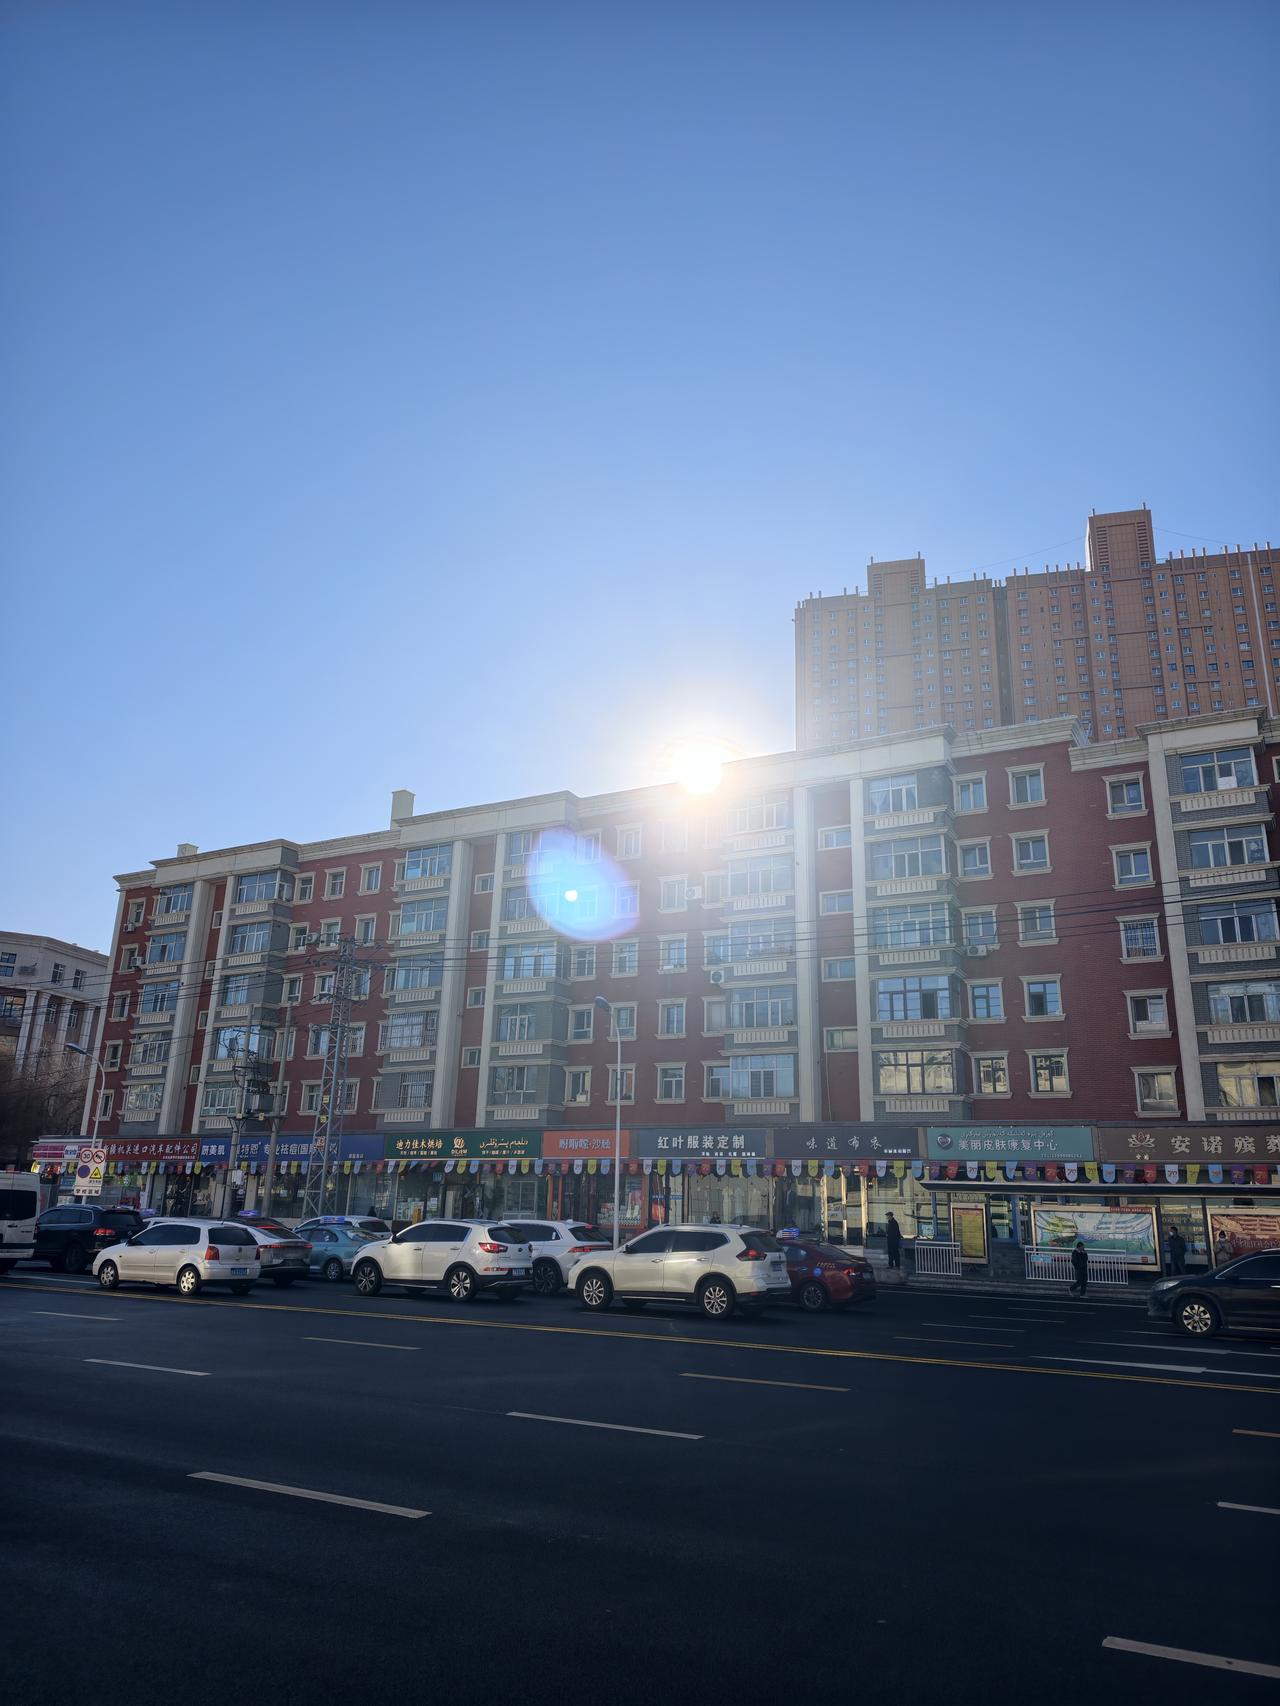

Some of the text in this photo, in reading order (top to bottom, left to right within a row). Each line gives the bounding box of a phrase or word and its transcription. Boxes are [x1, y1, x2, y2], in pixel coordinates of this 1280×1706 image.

[657, 1135, 745, 1149] 红叶服装定制
[806, 1136, 882, 1150] 味道布衣
[958, 1139, 1058, 1151] 美丽皮肤康复中心
